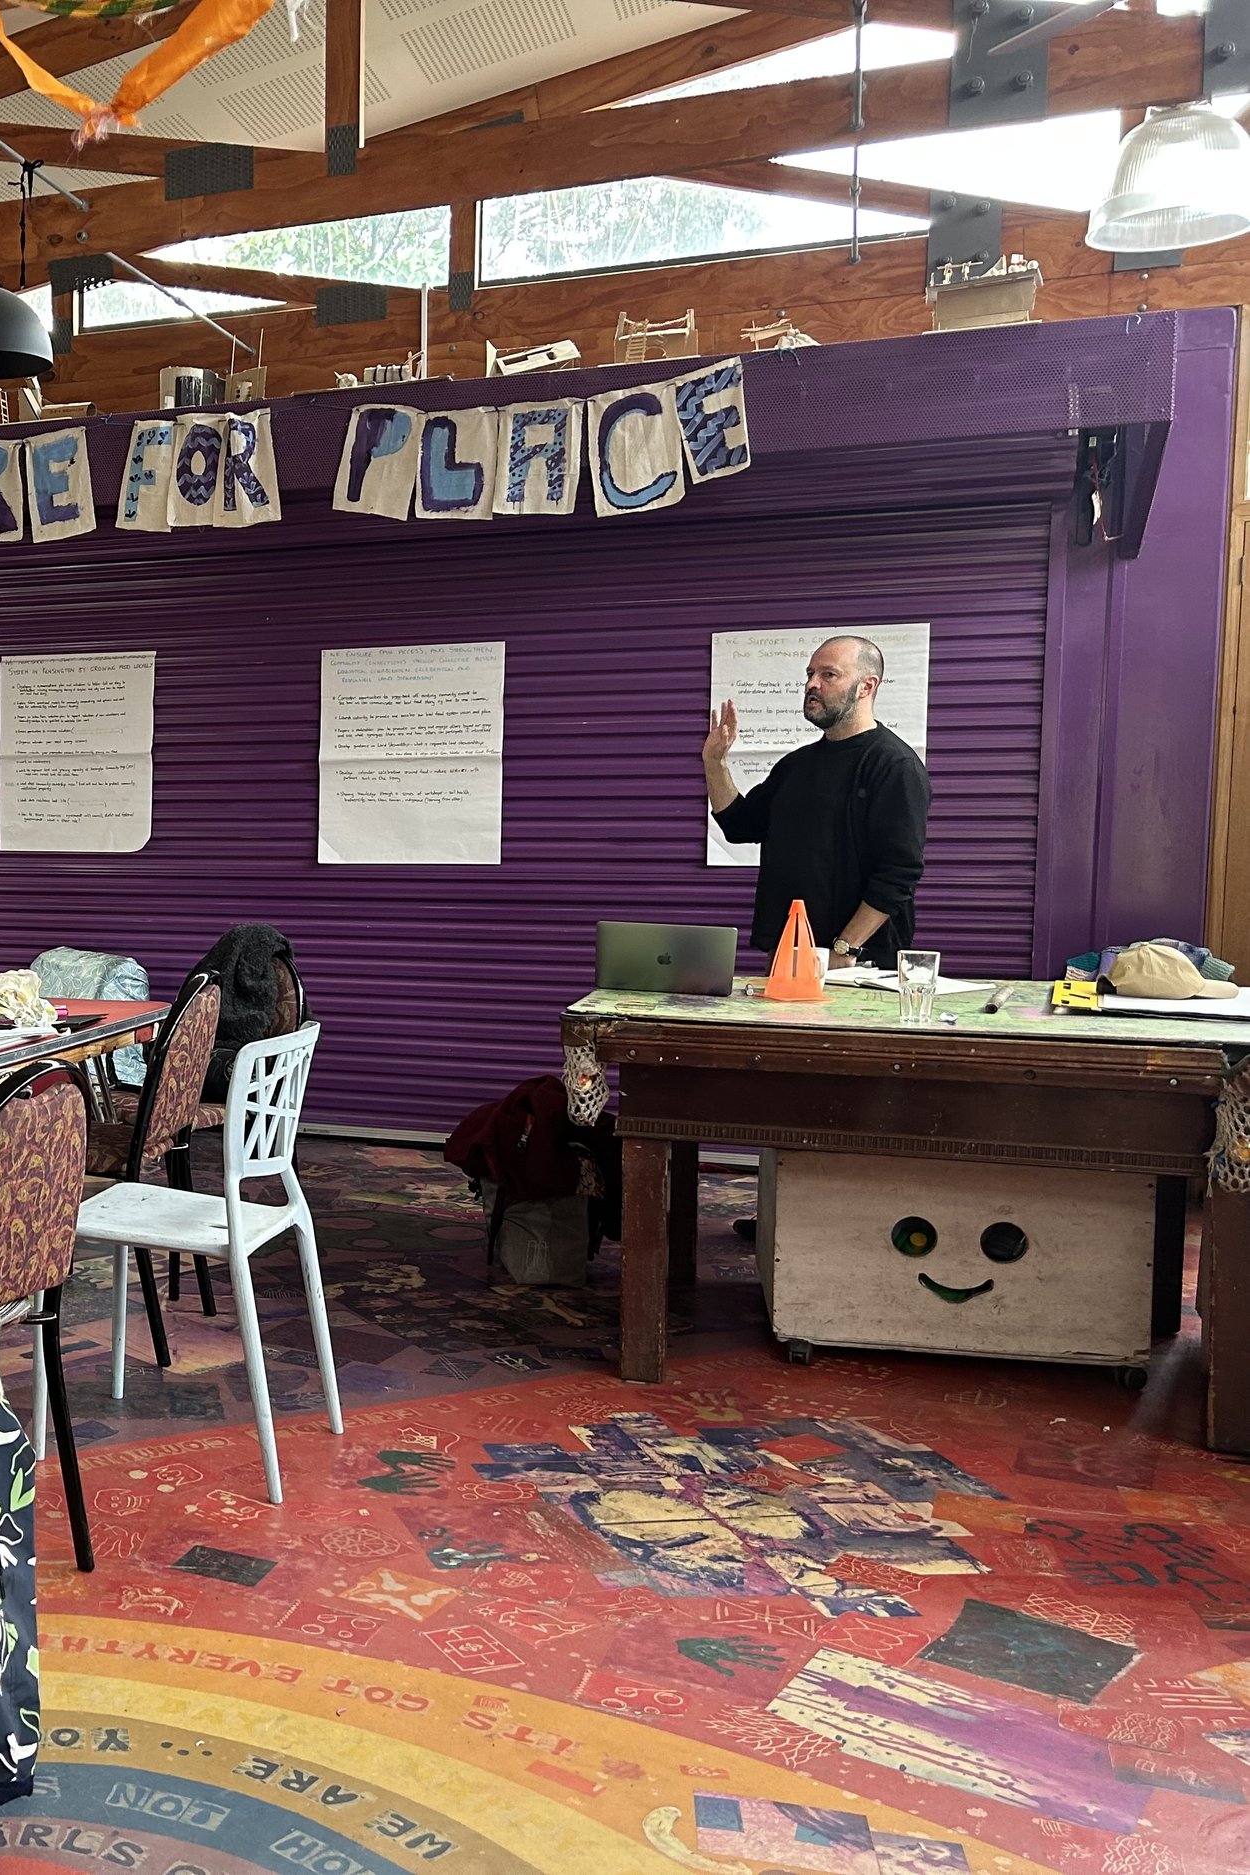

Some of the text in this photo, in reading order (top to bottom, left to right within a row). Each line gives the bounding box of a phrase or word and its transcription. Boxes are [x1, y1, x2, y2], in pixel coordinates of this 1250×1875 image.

[123, 418, 271, 522] FOR
[347, 366, 748, 513] PLACE
[748, 636, 788, 646] SUPPORT
[321, 1676, 434, 1714] GOT
[238, 1752, 366, 1808] ARE
[105, 1783, 230, 1831] NOT
[364, 1810, 458, 1861] WE
